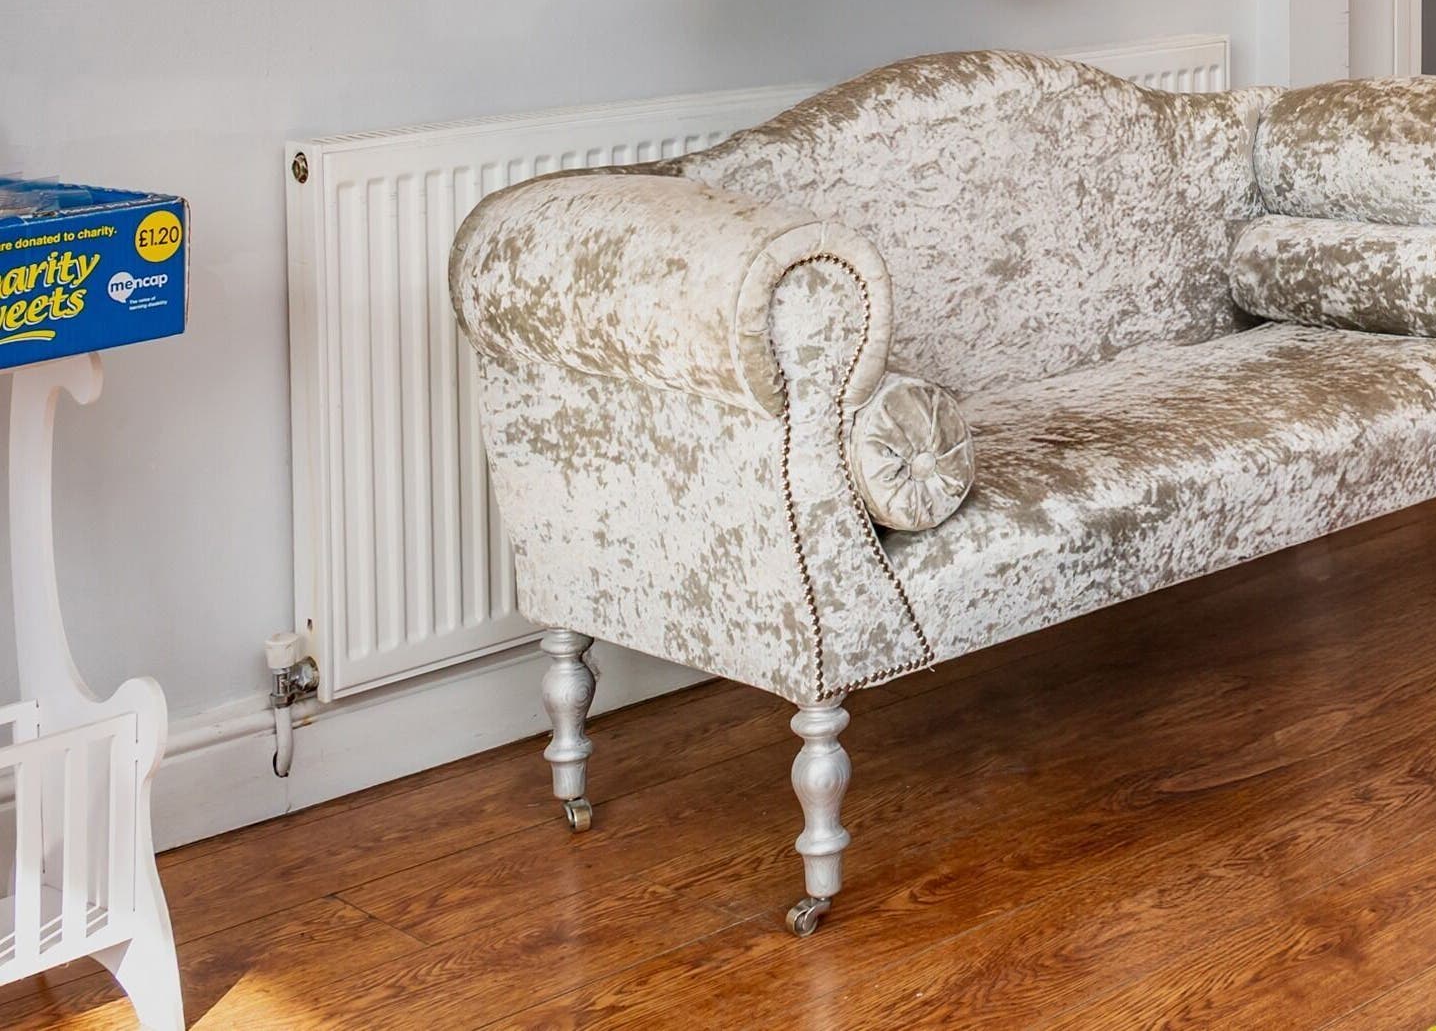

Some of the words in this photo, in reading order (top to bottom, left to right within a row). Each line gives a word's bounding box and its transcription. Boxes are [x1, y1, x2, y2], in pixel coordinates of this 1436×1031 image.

[15, 233, 61, 250] donated
[64, 232, 75, 242] to
[77, 225, 118, 240] charity.
[139, 226, 180, 248] £1.20
[0, 251, 101, 298] arity
[110, 273, 169, 293] mencap
[0, 286, 87, 332] eets
